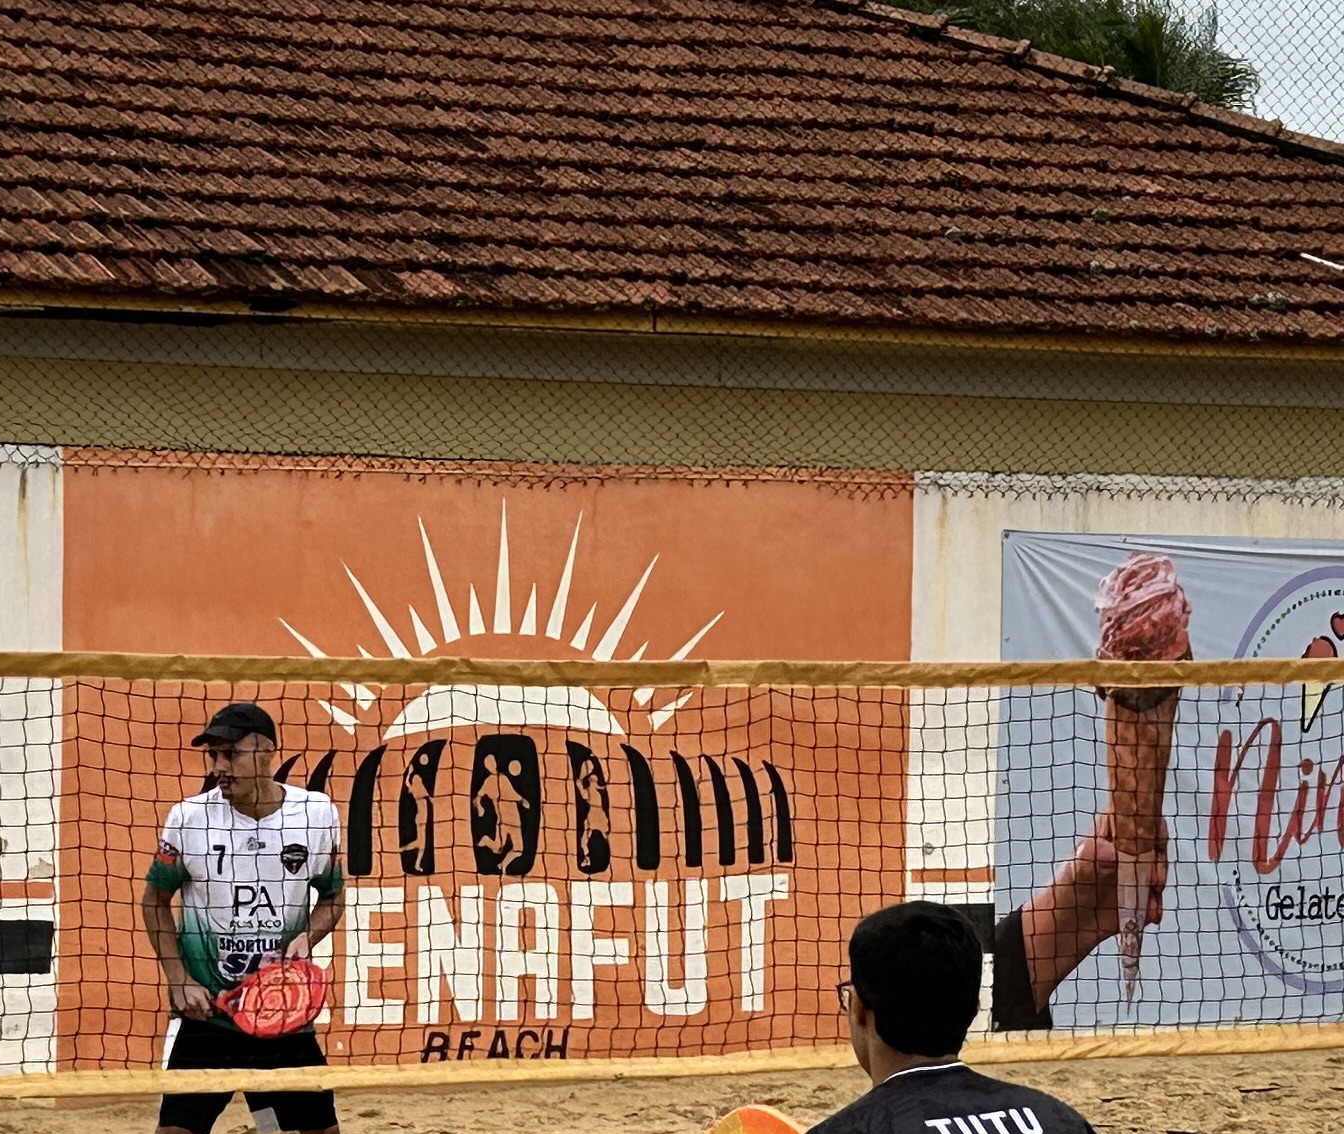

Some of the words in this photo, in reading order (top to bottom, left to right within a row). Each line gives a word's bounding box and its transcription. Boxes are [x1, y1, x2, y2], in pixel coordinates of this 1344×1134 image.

[212, 844, 226, 875] 7
[233, 885, 277, 917] PA
[311, 873, 790, 1026] ENAFUT
